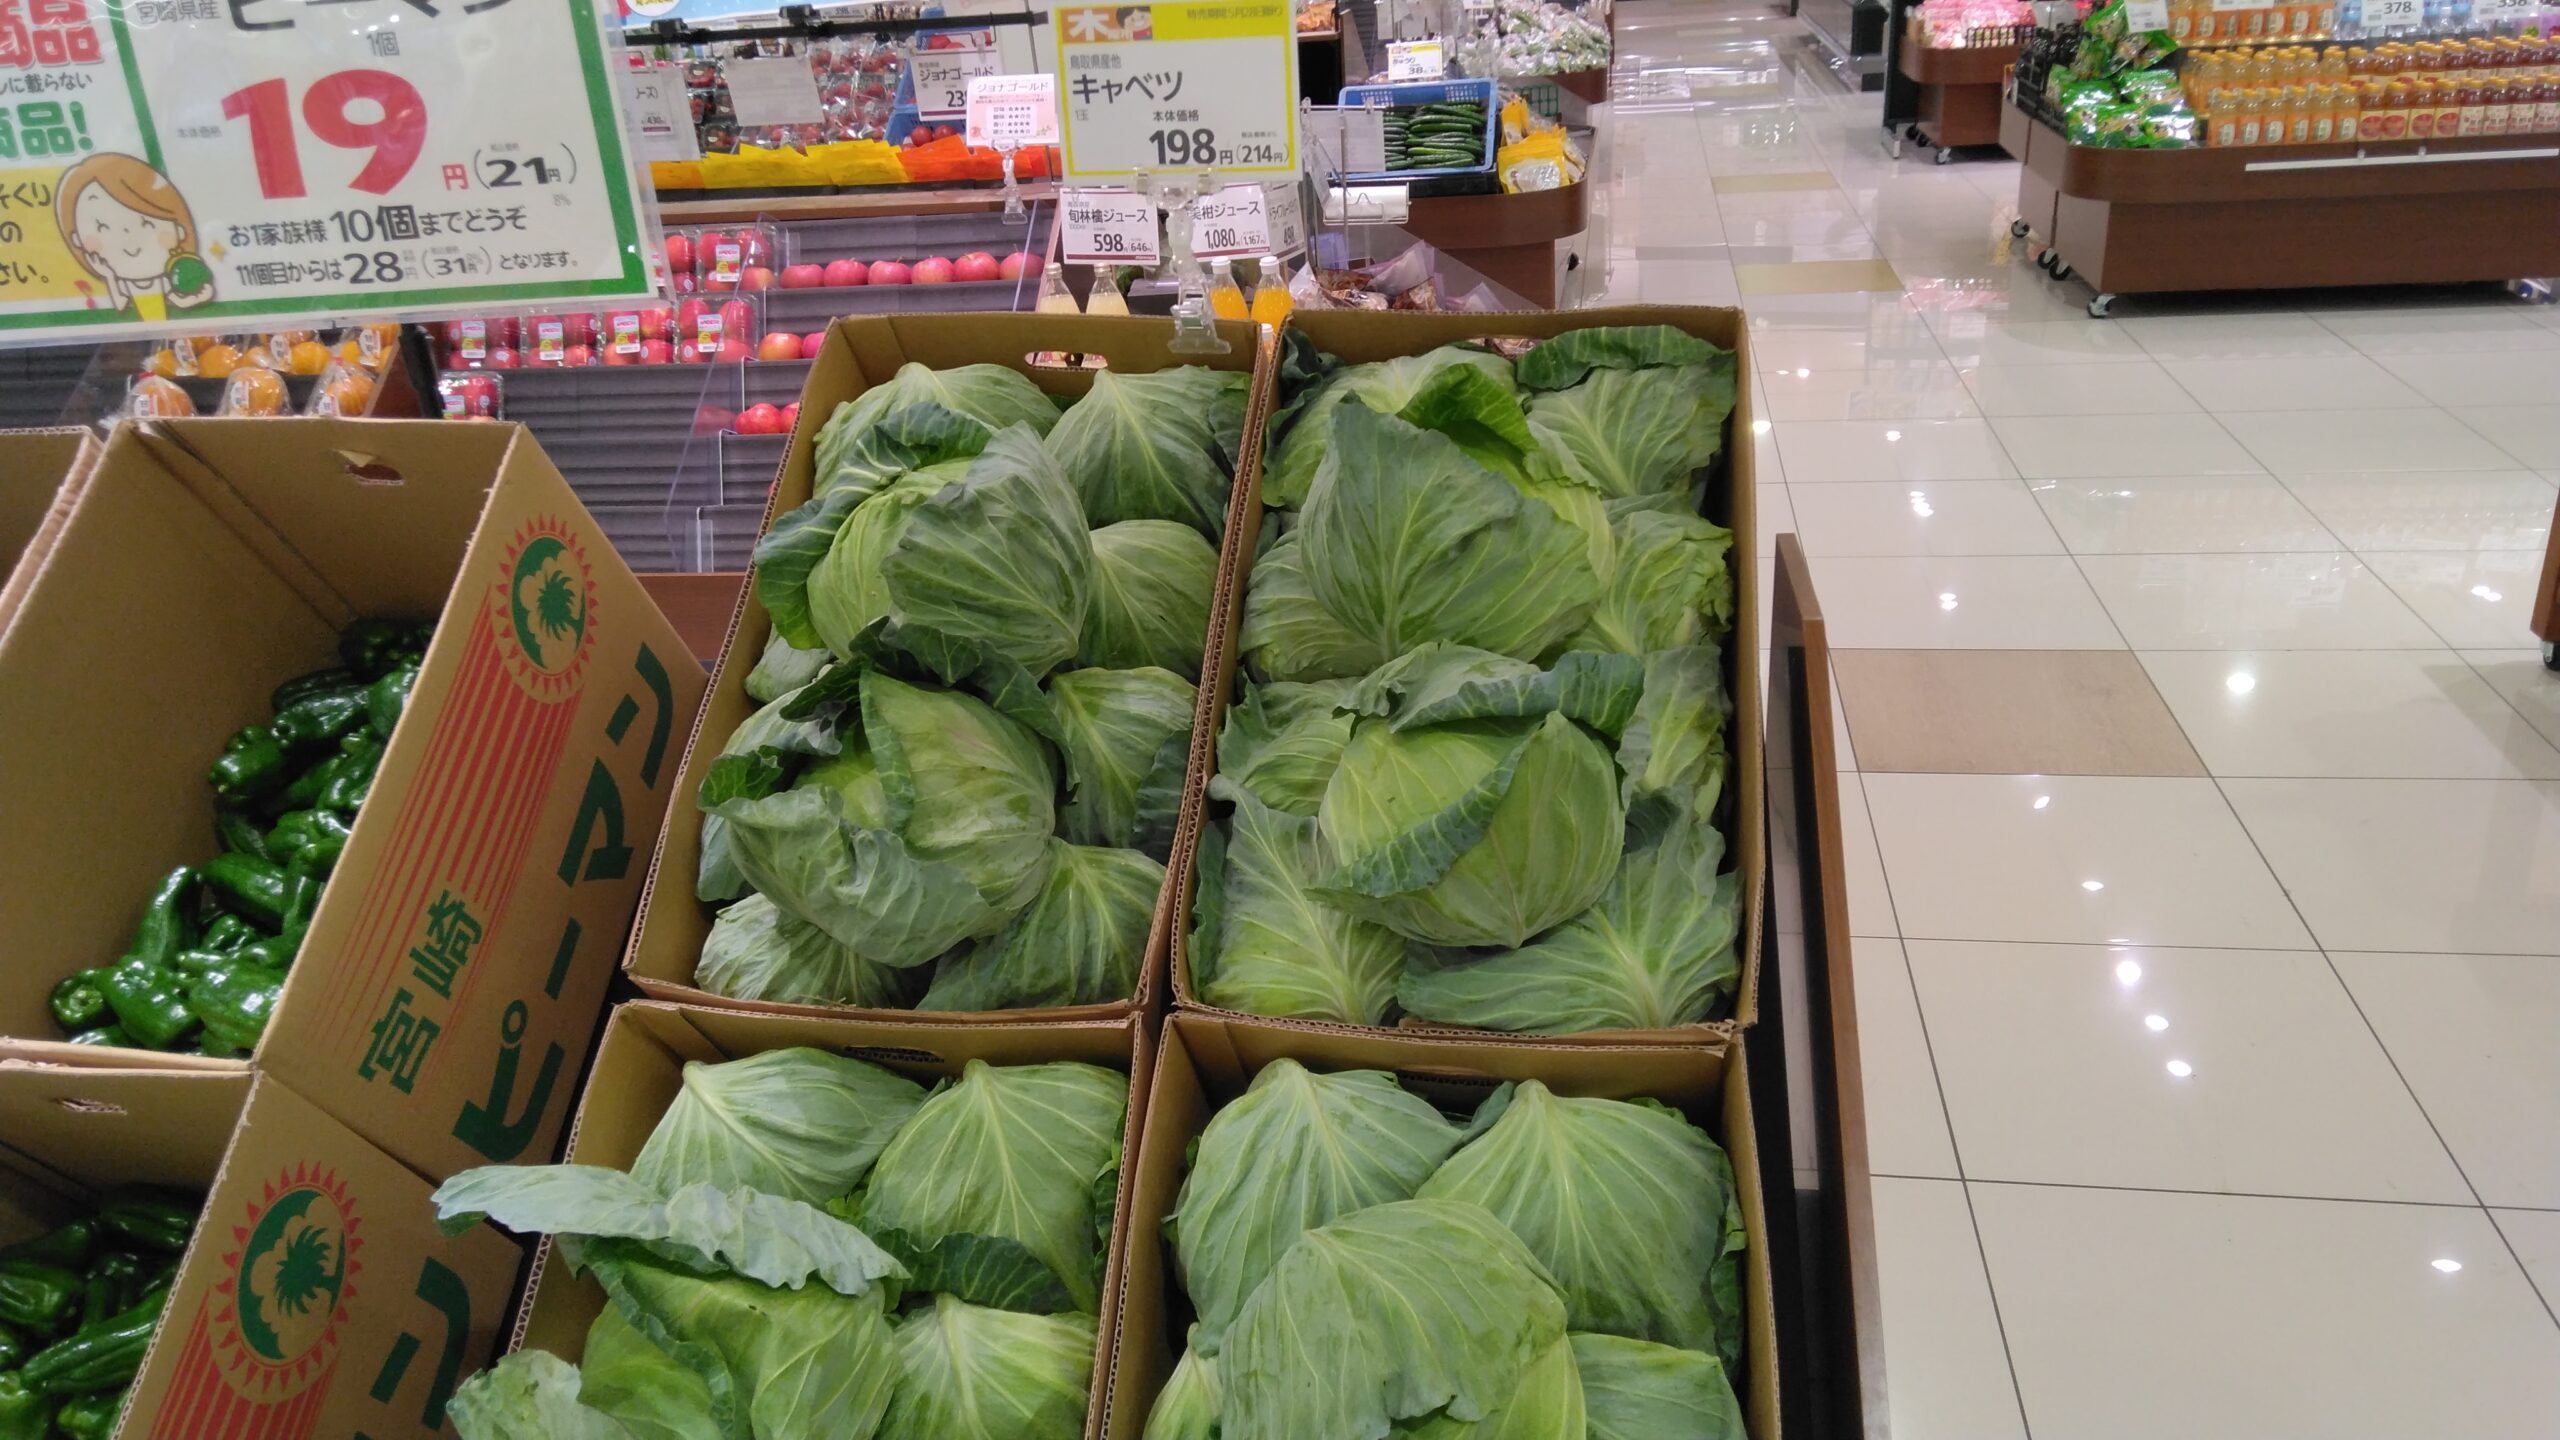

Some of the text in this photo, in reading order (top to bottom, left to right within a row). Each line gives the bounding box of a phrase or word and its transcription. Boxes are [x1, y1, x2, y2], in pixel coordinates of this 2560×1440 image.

[2384, 1, 2412, 14] 378
[1067, 9, 1112, 41] 木
[945, 90, 969, 107] 23
[977, 81, 1048, 93] ジョナゴールド
[1072, 71, 1183, 104] キャベツ
[1153, 109, 1199, 123] 本体価格
[452, 641, 675, 1162] ピーマン
[358, 889, 483, 1096] 宮崎
